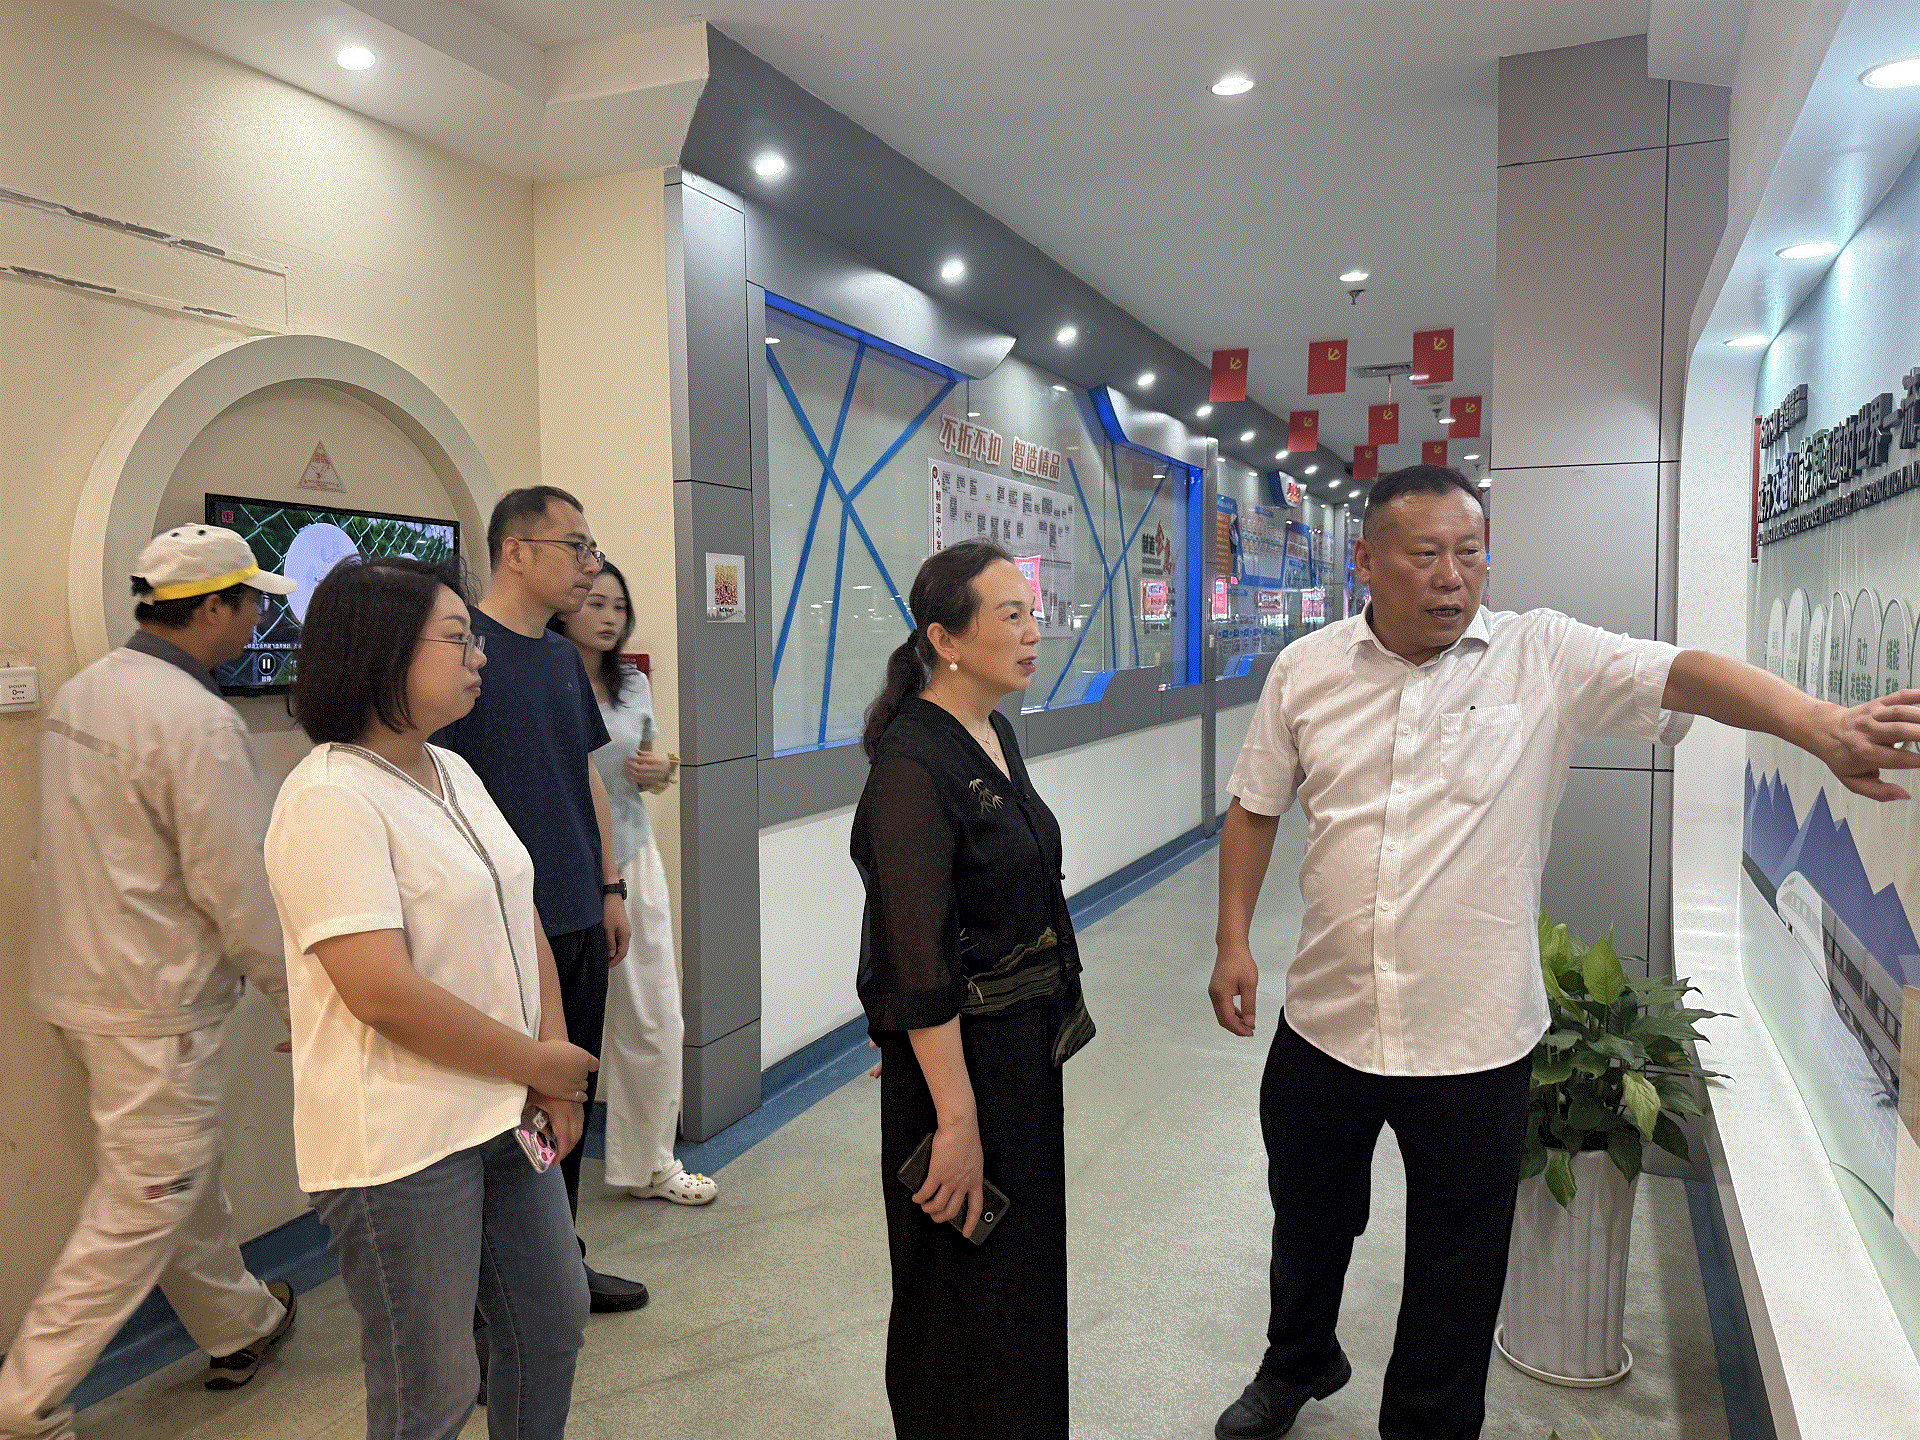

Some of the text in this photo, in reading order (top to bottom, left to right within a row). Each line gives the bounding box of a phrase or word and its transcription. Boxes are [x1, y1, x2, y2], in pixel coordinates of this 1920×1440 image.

[941, 416, 1061, 480] 不折不扣 智造精品
